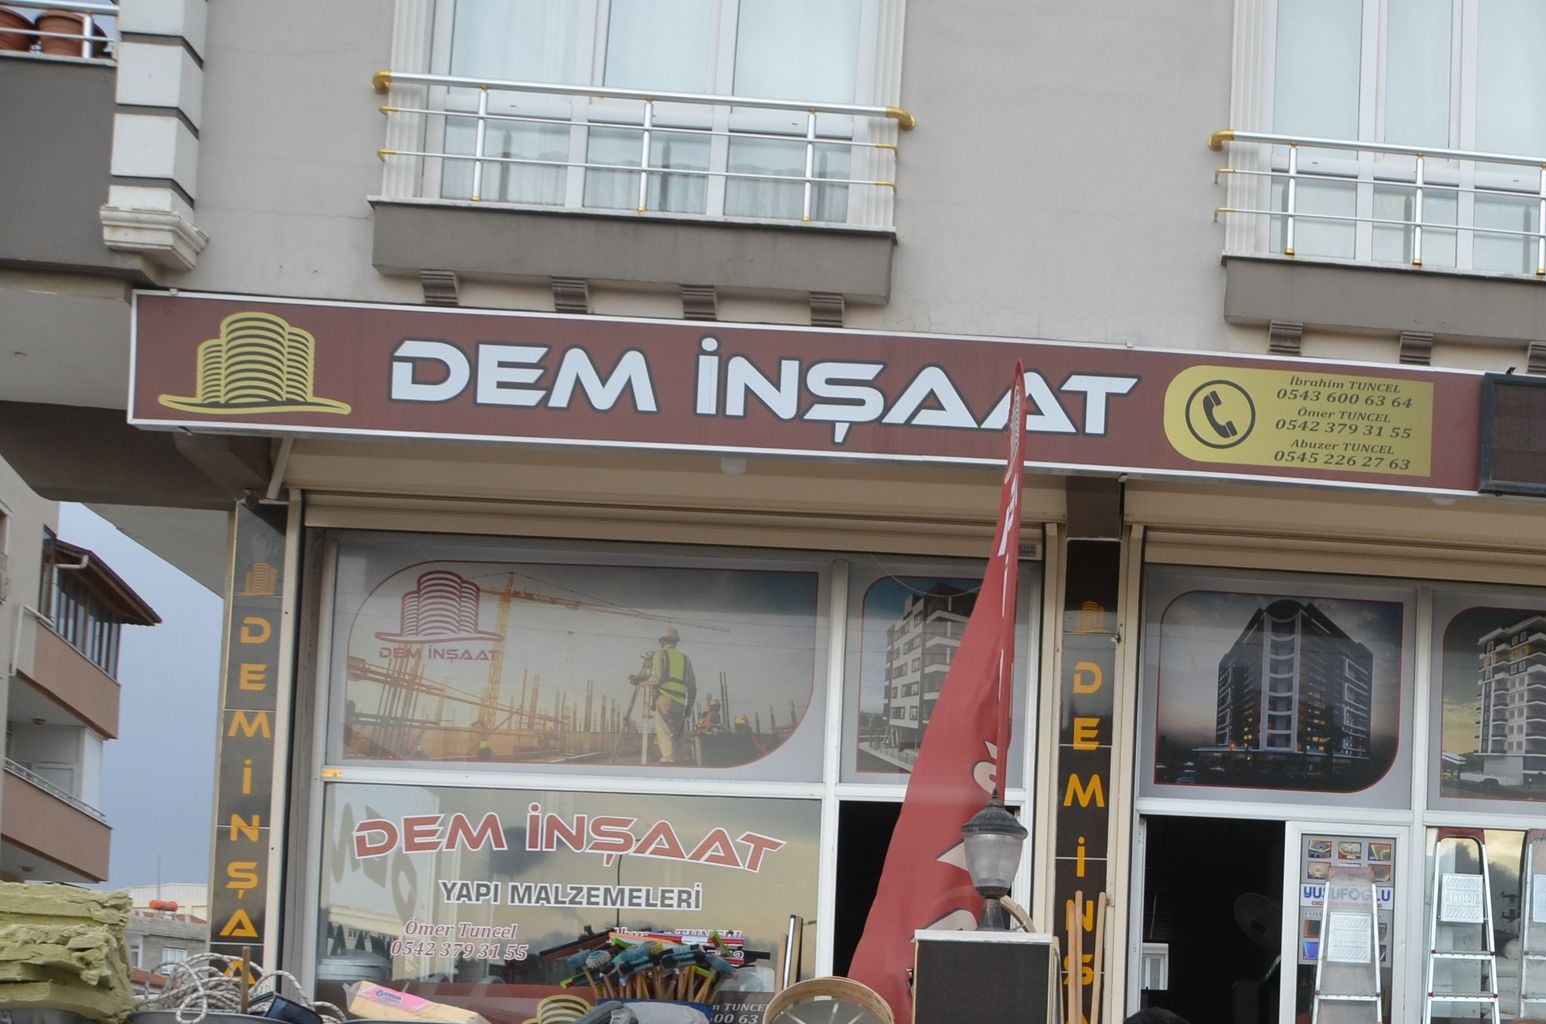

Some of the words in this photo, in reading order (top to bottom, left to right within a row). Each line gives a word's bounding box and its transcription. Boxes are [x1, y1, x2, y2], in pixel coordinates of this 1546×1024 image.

[389, 338, 658, 413] DEM
[695, 336, 1140, 444] İNŞAAT
[1289, 375, 1345, 390] İbrahim
[1349, 380, 1401, 394] TUNCEL
[1276, 387, 1321, 402] 0543
[1326, 391, 1360, 405] 600
[1364, 394, 1386, 407] 63
[1391, 397, 1414, 409] 64
[1297, 407, 1335, 419] Ömer
[1339, 410, 1391, 423] TUNCEL
[1275, 418, 1320, 432] 0542
[1324, 422, 1359, 435] 379
[1362, 424, 1384, 437] 31
[1389, 426, 1413, 439] 55
[1290, 439, 1339, 451] Abuzer
[1342, 442, 1395, 455] TUNCEL
[1273, 449, 1320, 464] 0545
[1323, 453, 1358, 467] 226
[1361, 456, 1385, 468] 27
[1388, 458, 1411, 471] 63
[378, 646, 421, 660] DEM
[427, 644, 500, 664] İNŞAAT
[353, 812, 508, 859] DEM
[524, 802, 788, 873] İNŞAAT
[439, 879, 501, 905] YAPI
[508, 881, 703, 911] MALZEMELERİ
[404, 918, 454, 938] Ömer
[458, 922, 519, 940] Tuncel
[389, 939, 436, 957] 0542
[439, 942, 475, 959] 379
[478, 943, 501, 960] 31
[503, 943, 530, 961] 55
[723, 1002, 769, 1013] TUNCE
[738, 1013, 759, 1024] 63
